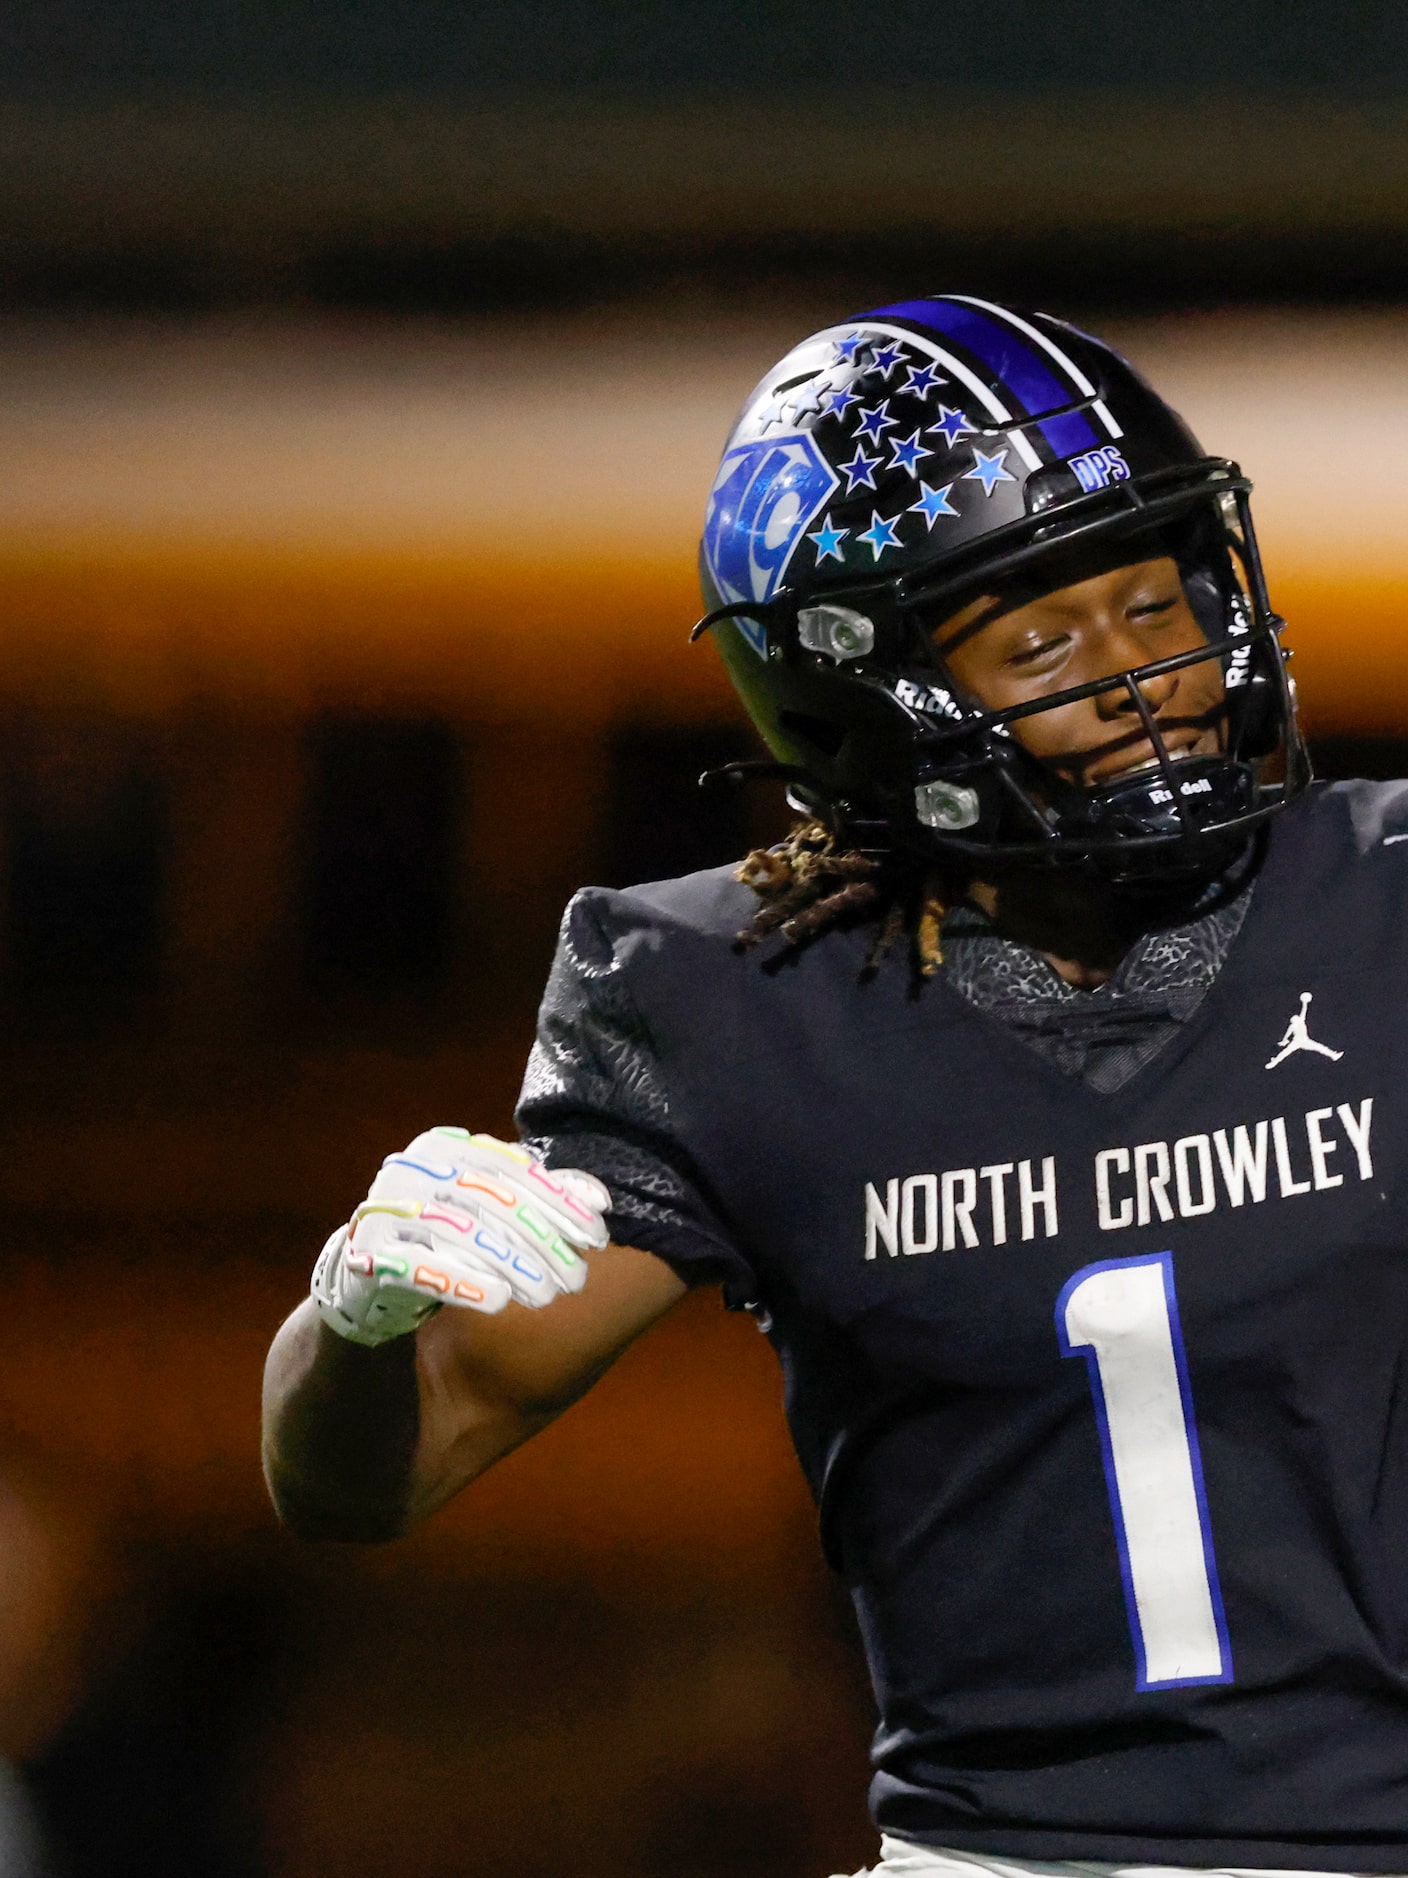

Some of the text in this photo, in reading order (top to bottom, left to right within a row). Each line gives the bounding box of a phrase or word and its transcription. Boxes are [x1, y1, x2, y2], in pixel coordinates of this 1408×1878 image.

[1067, 445, 1132, 494] DPS
[1148, 778, 1213, 805] Ridell
[864, 1098, 1375, 1260] NORTH CROWLEY
[1054, 1250, 1234, 1692] 1
